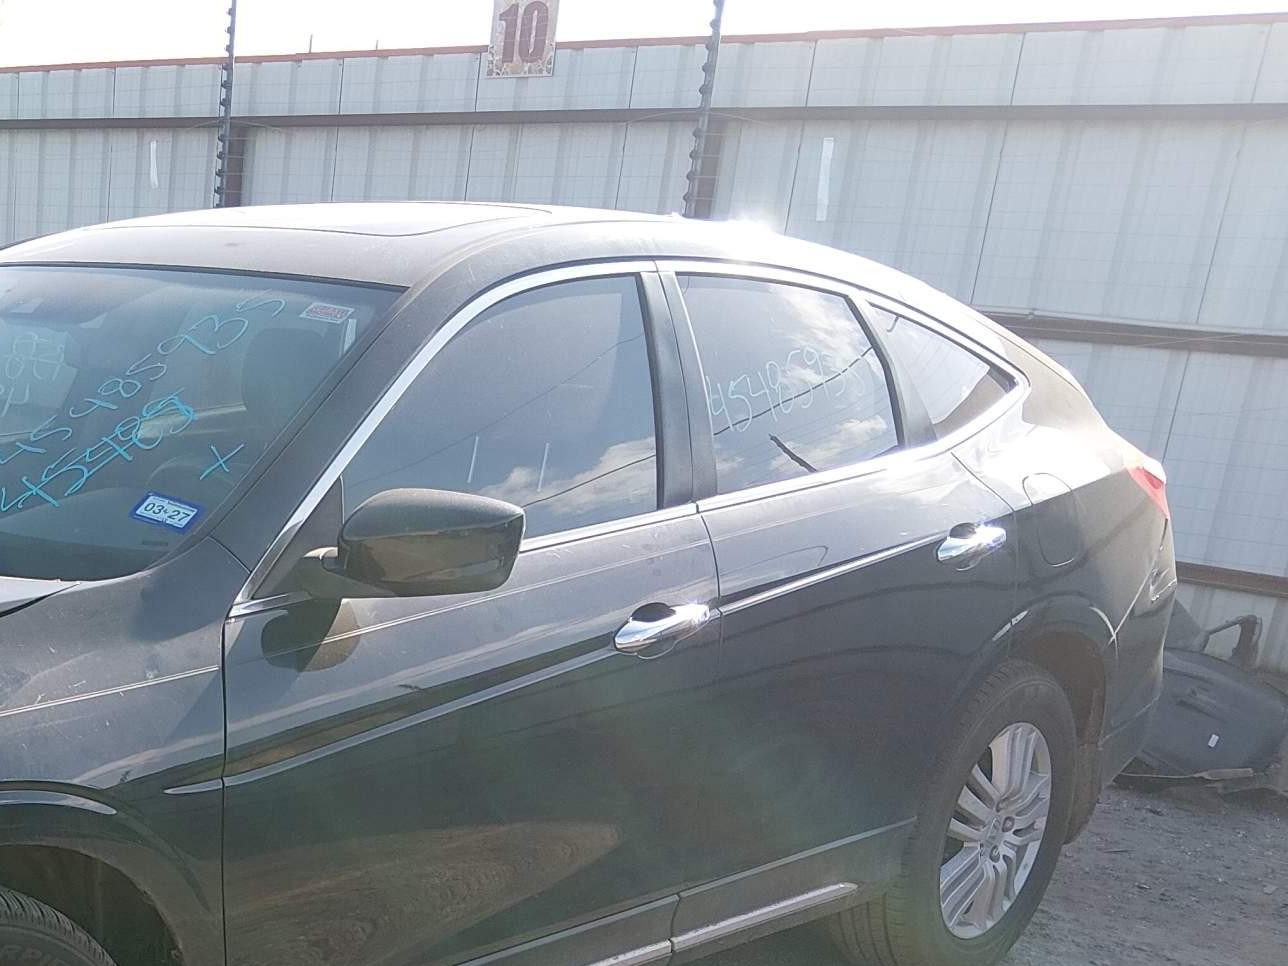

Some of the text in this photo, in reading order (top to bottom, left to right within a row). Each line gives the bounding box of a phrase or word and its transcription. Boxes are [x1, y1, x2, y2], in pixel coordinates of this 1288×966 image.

[499, 1, 549, 63] 10
[144, 502, 190, 522] 03 27
